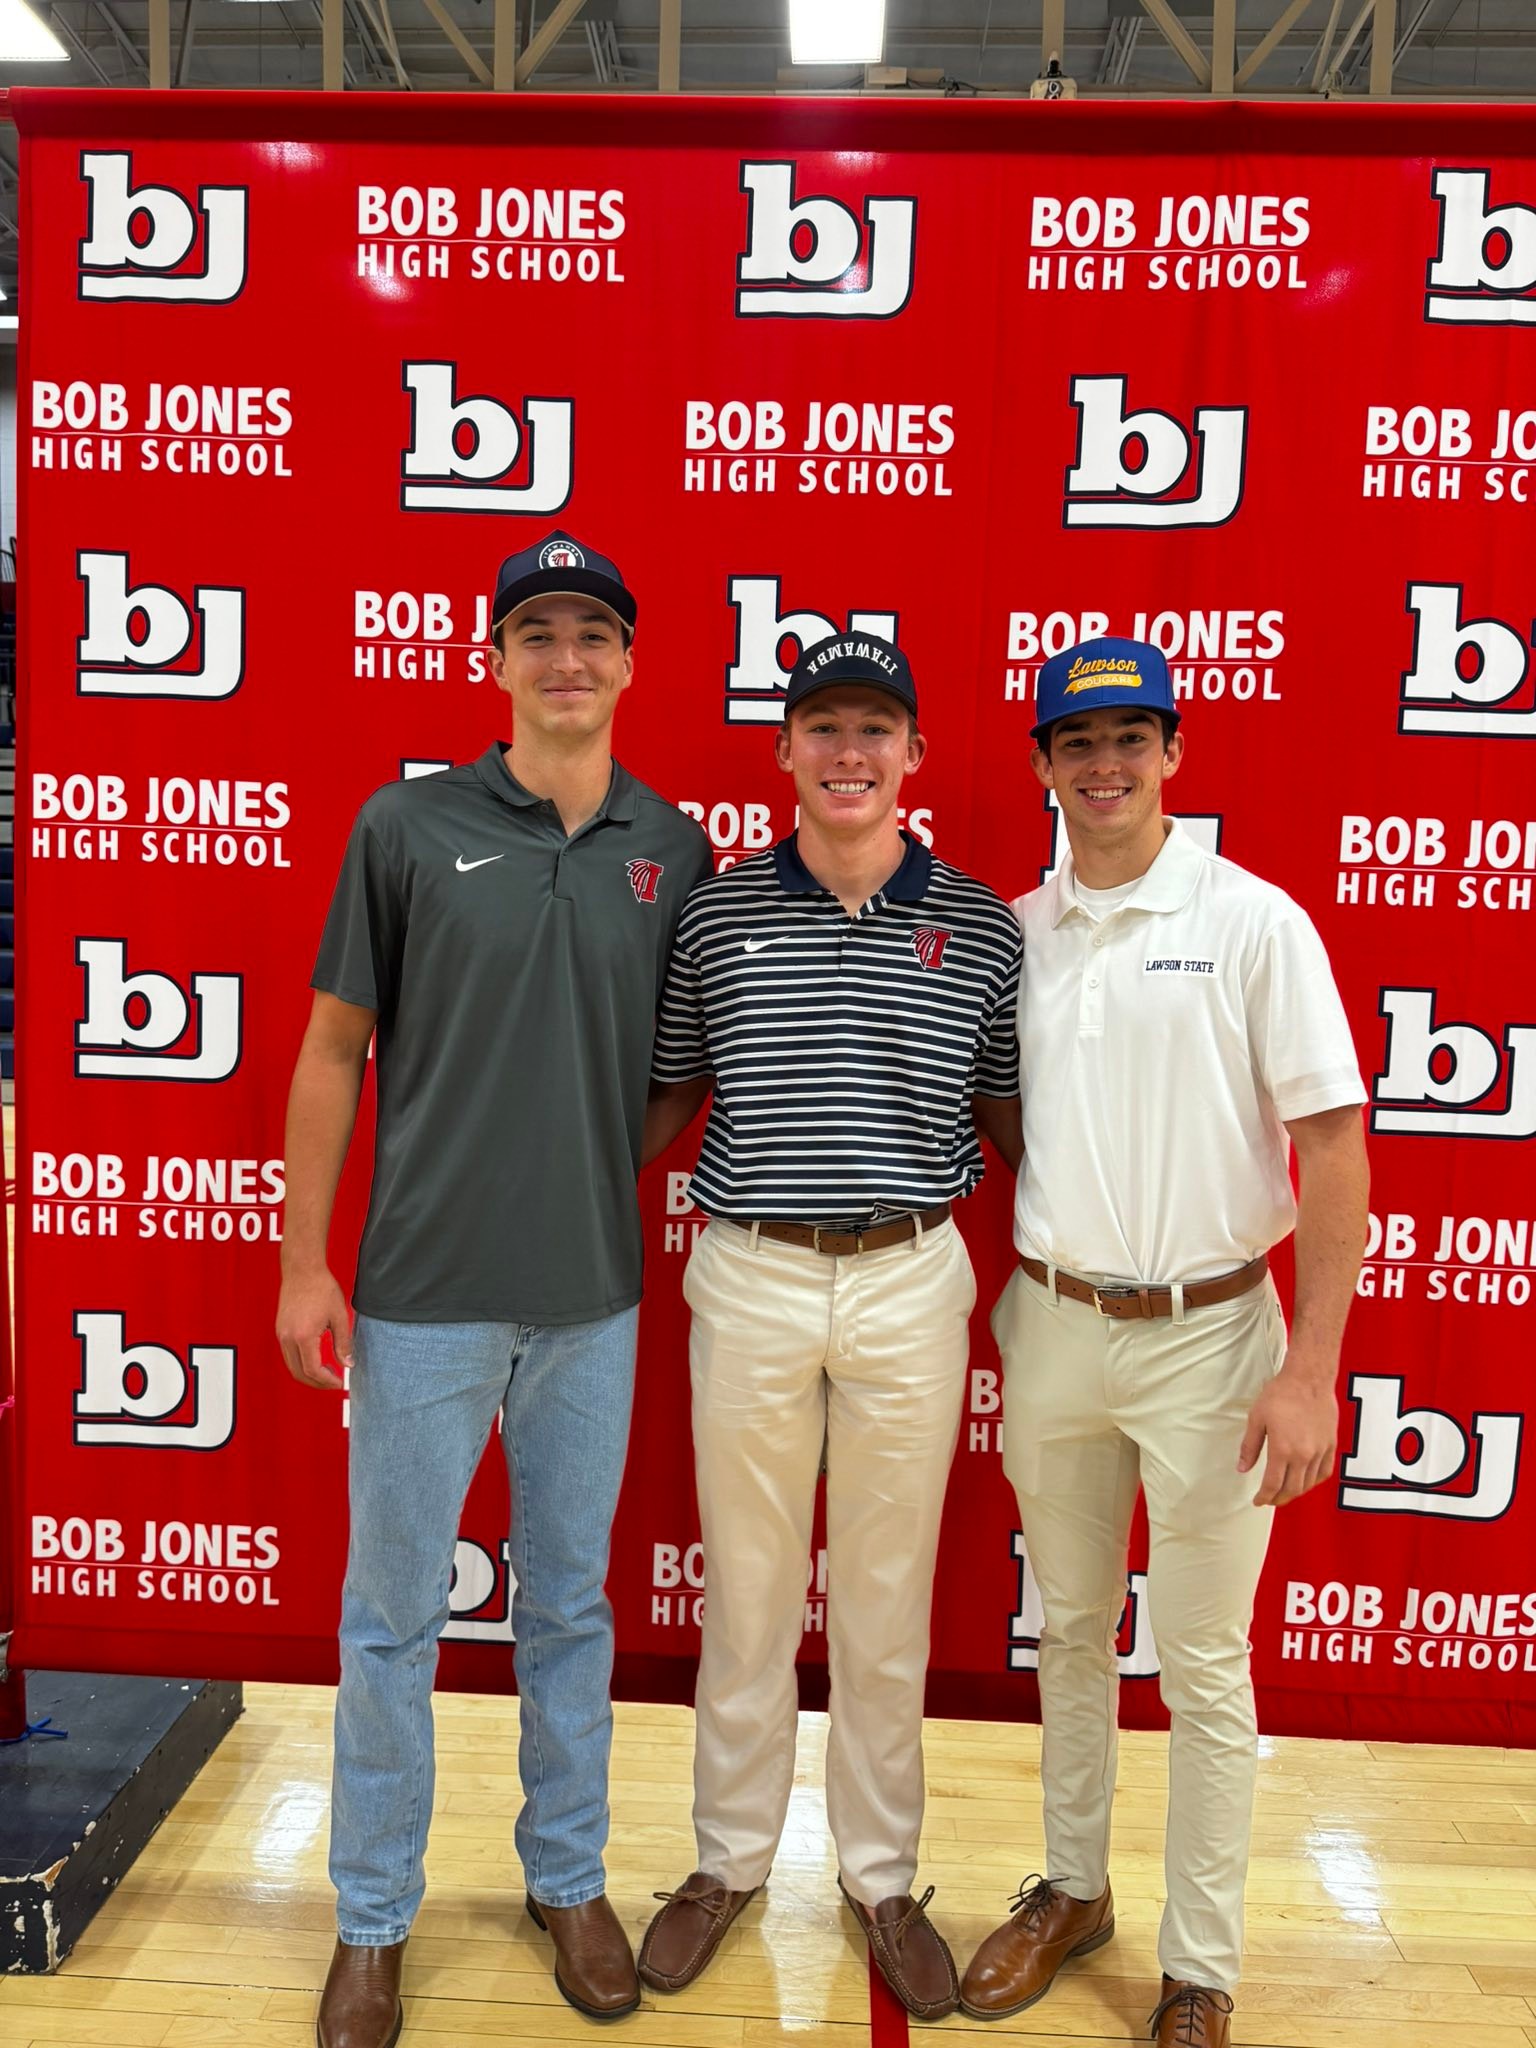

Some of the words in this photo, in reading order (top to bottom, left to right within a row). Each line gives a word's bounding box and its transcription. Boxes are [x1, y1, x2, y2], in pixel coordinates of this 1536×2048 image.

[80, 150, 249, 304] bj
[358, 186, 458, 237] BOB
[475, 187, 626, 240] JONES
[1030, 196, 1137, 248] BOB
[1154, 194, 1310, 248] JONES
[357, 243, 449, 279] HIGH
[471, 246, 625, 282] SCHOOL
[736, 160, 918, 319] bj
[1425, 168, 1536, 324] b
[1028, 255, 1125, 290] HIGH
[1148, 253, 1307, 291] SCHOOL
[32, 381, 129, 431] BOB
[145, 383, 292, 436] JONES
[685, 400, 787, 451] BOB
[803, 402, 955, 455] JONES
[1365, 405, 1473, 458] BOB
[32, 436, 122, 471] HIGH
[141, 438, 292, 477] SCHOOL
[400, 359, 575, 516] bj
[1063, 373, 1249, 529] bj
[684, 458, 776, 493] HIGH
[798, 459, 952, 496] SCHOOL
[1362, 464, 1461, 500] HIGH
[77, 549, 244, 700] bj
[355, 590, 454, 641] BOB
[354, 645, 445, 681] HIGH
[806, 641, 899, 676] ITAWAMBA
[1067, 655, 1139, 680] Lawson
[1172, 666, 1281, 701] HOOL
[1398, 580, 1536, 740] b
[33, 773, 128, 821] BOB
[145, 777, 291, 829] JONES
[32, 827, 119, 861] HIGH
[141, 831, 291, 868] SCHOOL
[1339, 815, 1447, 866] BOB
[1336, 871, 1435, 907] HIGH
[1145, 959, 1182, 972] LAWSON
[1183, 960, 1215, 974] STATE
[75, 936, 244, 1082] bj
[32, 1151, 126, 1198] BOB
[142, 1156, 286, 1205] JONES
[32, 1203, 118, 1236] HIGH
[138, 1207, 283, 1242] SCHOOL
[1433, 1215, 1536, 1267] JON
[1355, 1265, 1406, 1299] GH
[1426, 1269, 1532, 1306] SCHO
[73, 1310, 237, 1451] bj
[1339, 1371, 1525, 1521] bj
[32, 1515, 125, 1561] BOB
[141, 1520, 281, 1569] JONES
[653, 1542, 705, 1588] BO
[32, 1565, 117, 1598] HIGH
[138, 1570, 280, 1605] SCHOOL
[1284, 1580, 1384, 1629] BOB
[1399, 1587, 1536, 1638] JONES
[651, 1595, 705, 1627] HIG
[1281, 1630, 1374, 1664] HIGH
[1392, 1636, 1536, 1673] SCHOOL
